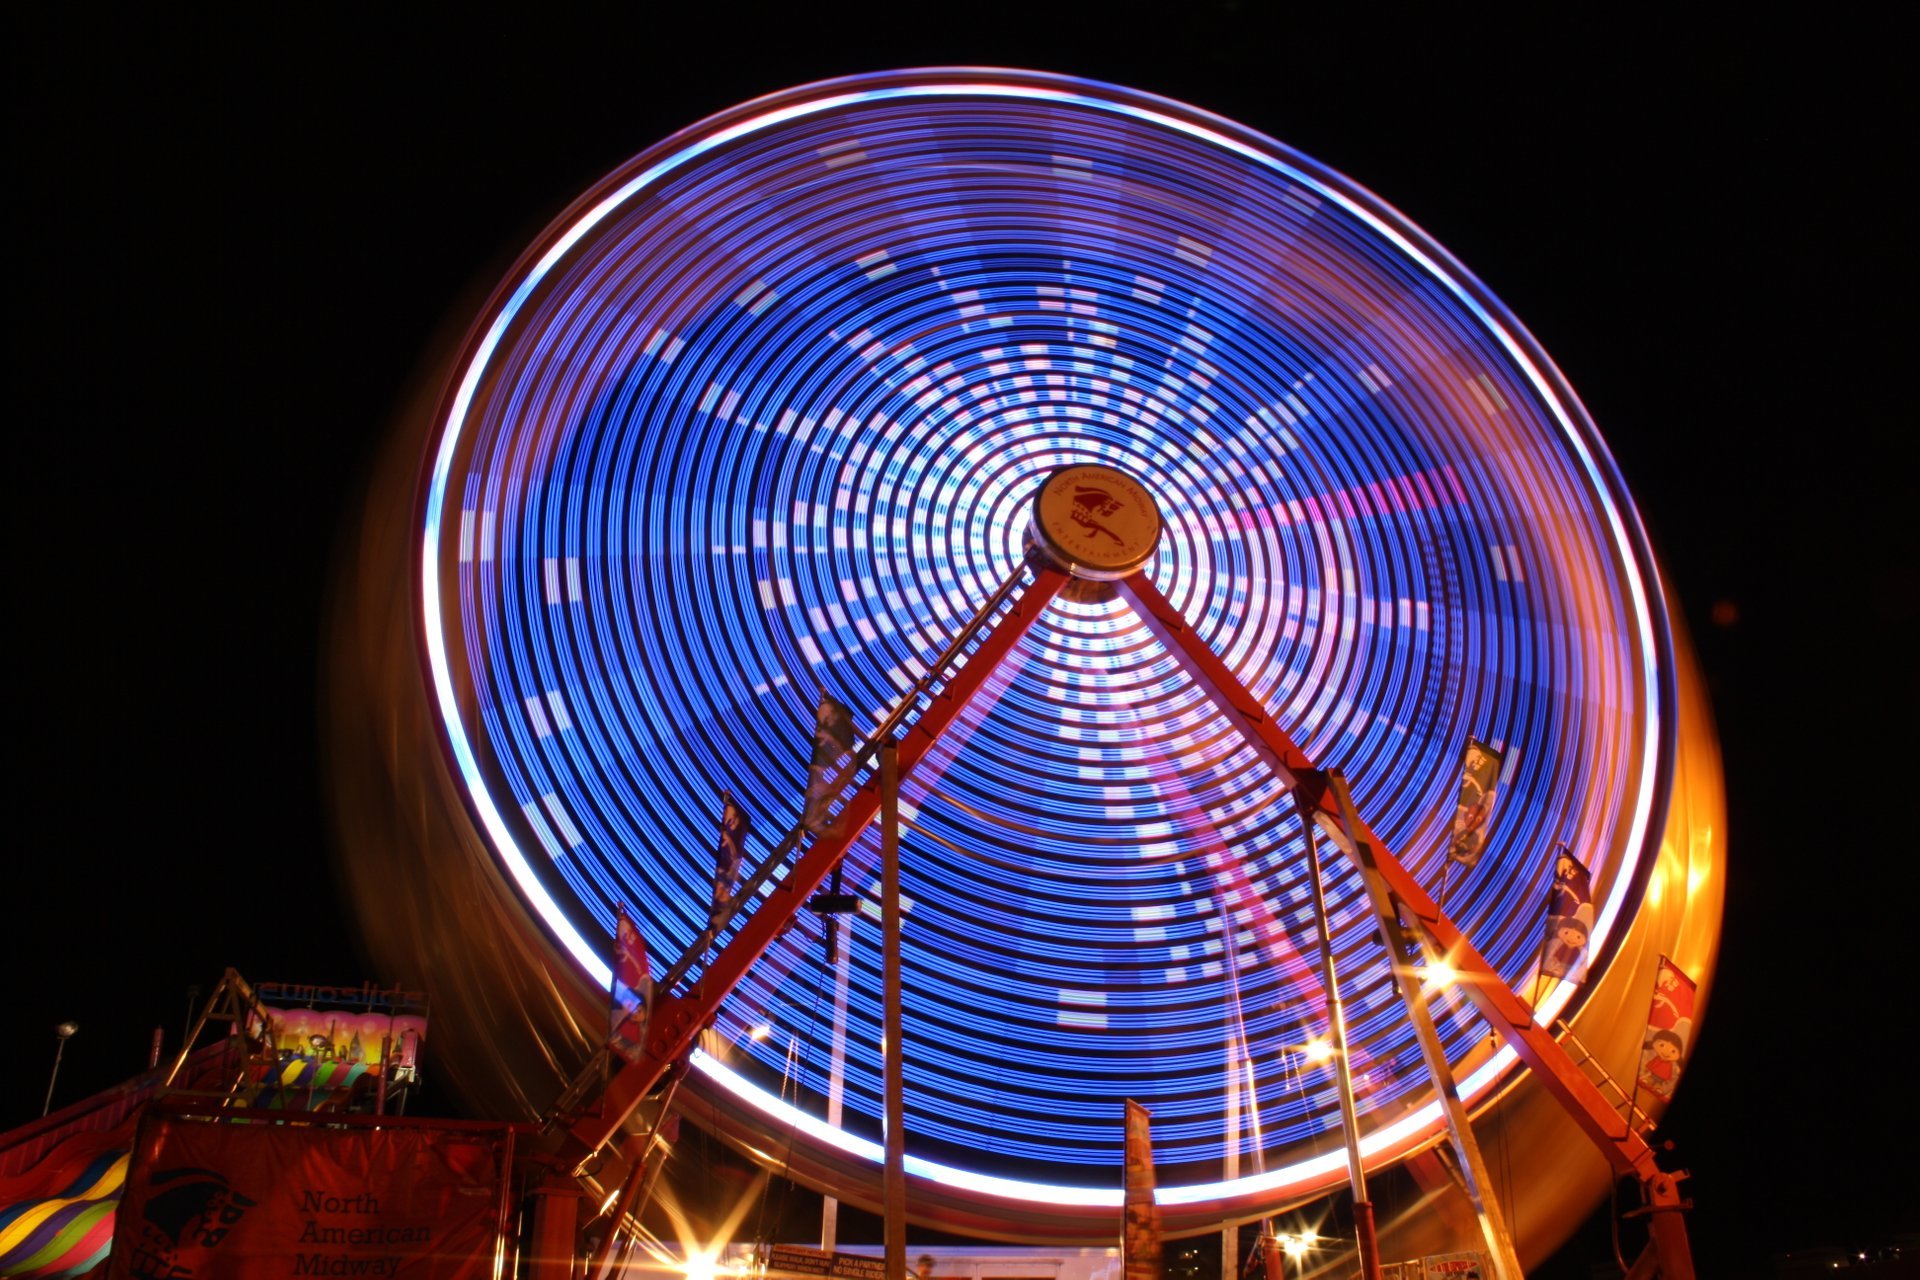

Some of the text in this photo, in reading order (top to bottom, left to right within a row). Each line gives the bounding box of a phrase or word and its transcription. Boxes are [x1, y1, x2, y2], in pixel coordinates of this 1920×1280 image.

[300, 1190, 380, 1215] North
[298, 1220, 431, 1246] American
[293, 1253, 402, 1278] Midway
